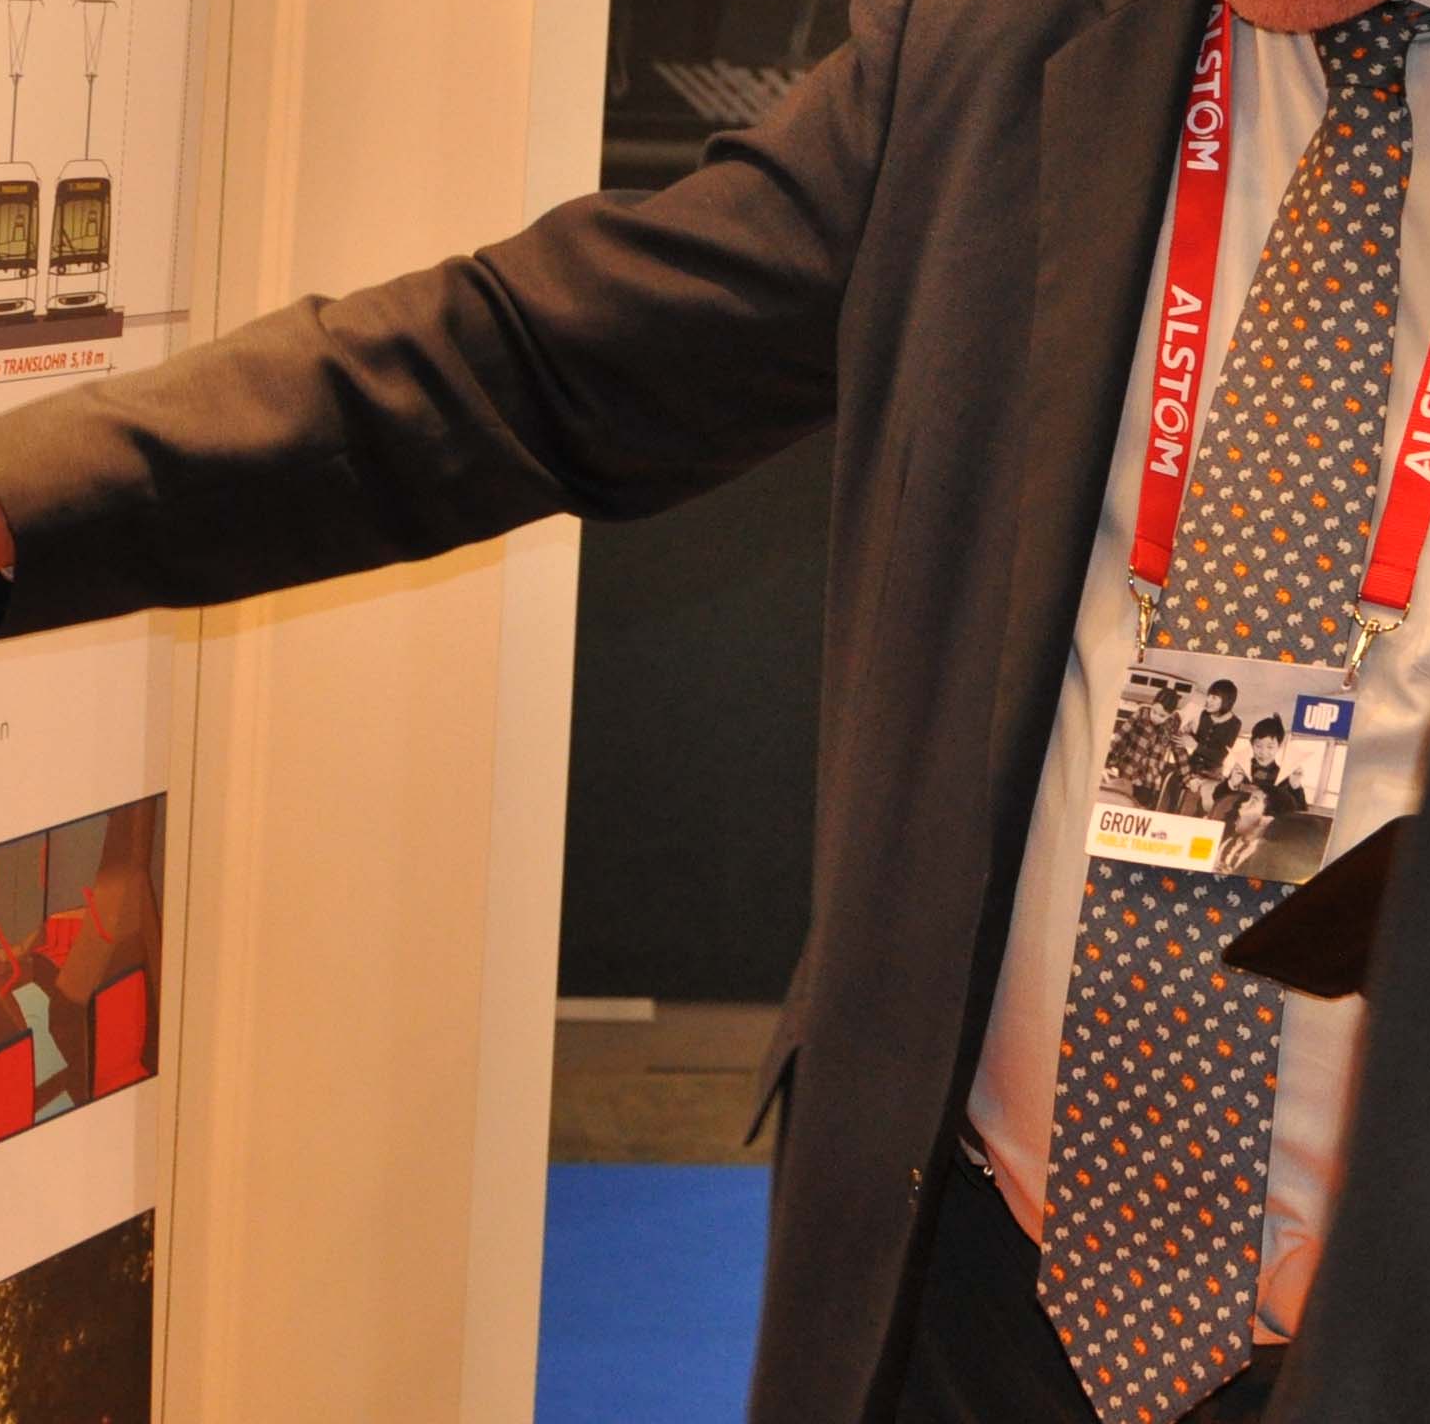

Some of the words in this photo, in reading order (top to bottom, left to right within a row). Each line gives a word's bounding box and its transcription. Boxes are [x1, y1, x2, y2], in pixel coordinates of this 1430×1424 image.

[1186, 4, 1224, 171] ALSTOM
[1, 354, 67, 376] TRANSLOHR
[94, 352, 105, 366] m
[1149, 282, 1204, 478] ALSTOM
[1100, 810, 1152, 837] GROW
[1151, 831, 1168, 840] with
